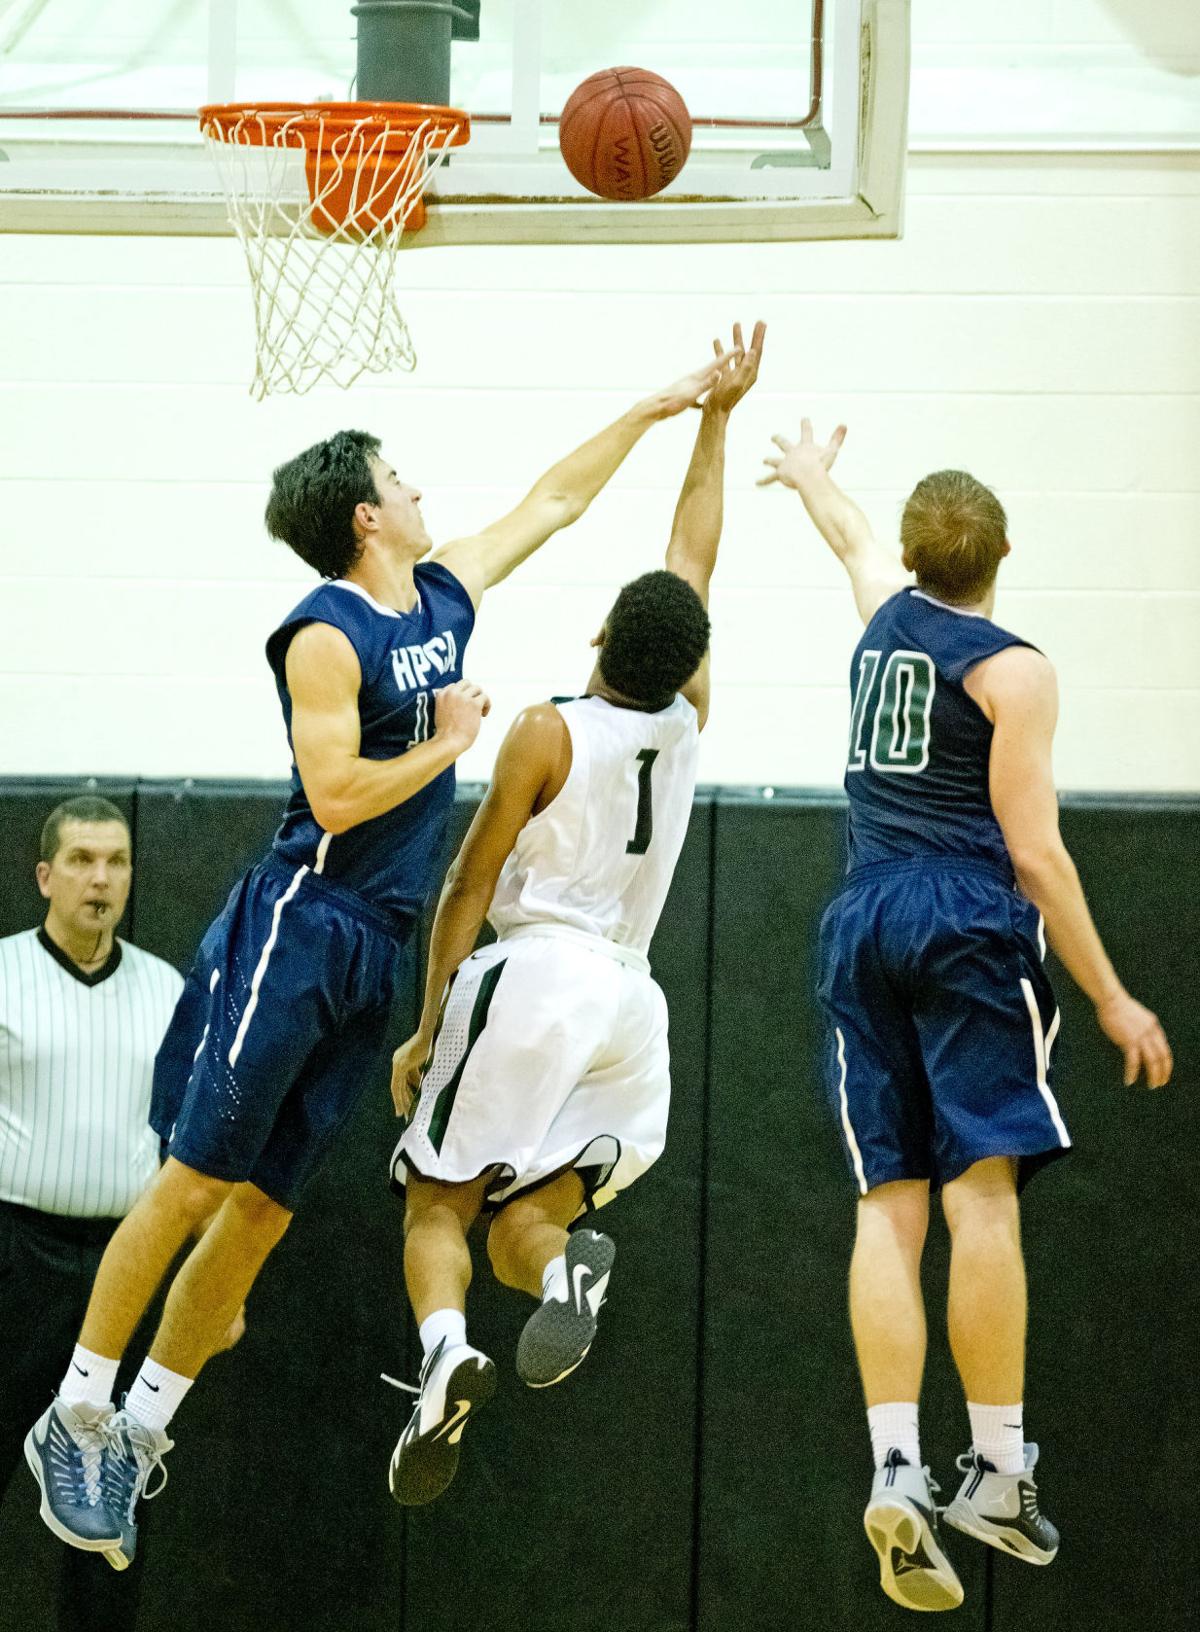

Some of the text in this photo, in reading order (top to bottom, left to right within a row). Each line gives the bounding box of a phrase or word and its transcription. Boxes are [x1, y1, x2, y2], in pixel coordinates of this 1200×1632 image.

[391, 630, 457, 691] HPCA
[847, 649, 936, 774] 10
[625, 748, 660, 855] 1
